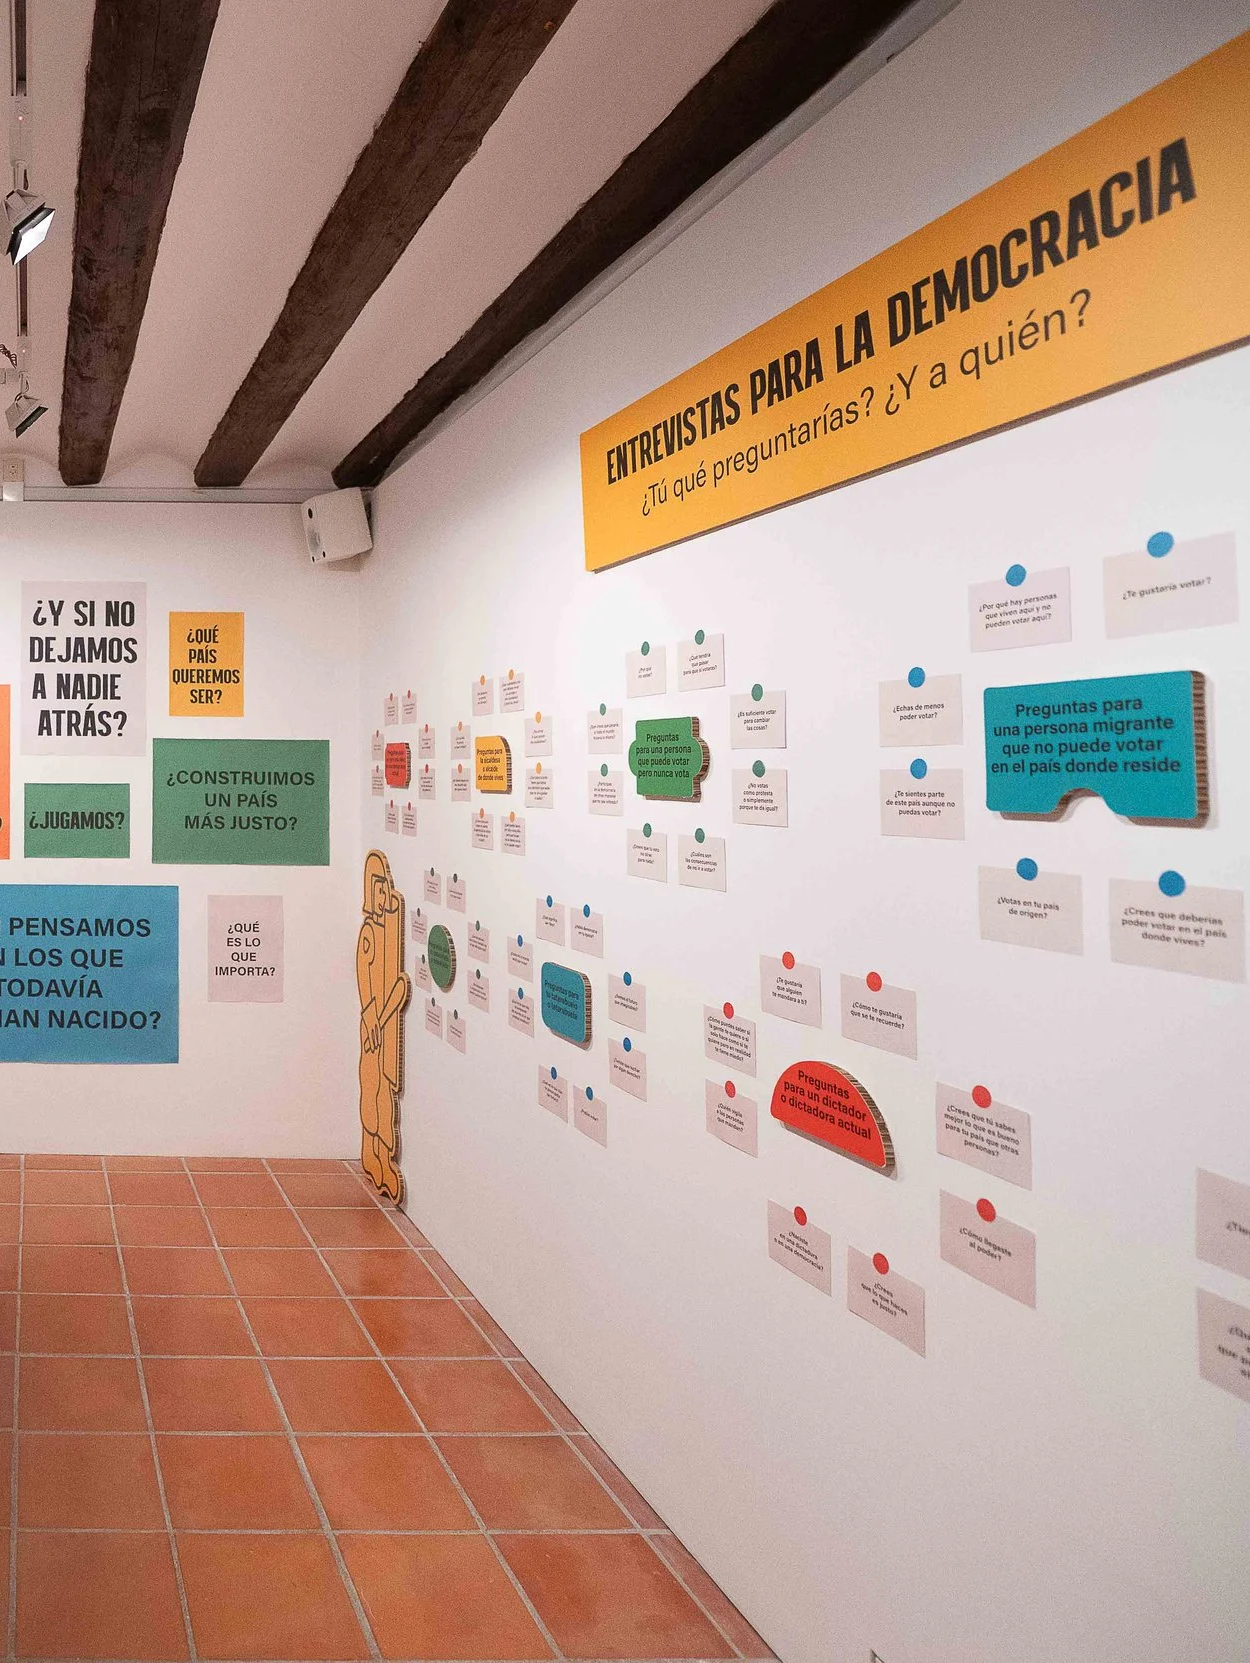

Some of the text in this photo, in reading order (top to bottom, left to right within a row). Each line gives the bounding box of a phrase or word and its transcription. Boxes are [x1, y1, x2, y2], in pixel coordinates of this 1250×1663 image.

[606, 136, 1197, 485] ENTREVISTAS PARA LA DEMOCRACIA
[642, 288, 1092, 516] ¿Tú qué preguntarías? ¿Y a quién?
[33, 600, 134, 626] ¿Y SI NO
[187, 625, 218, 644] ¿QUÉ
[30, 637, 137, 663] DEJAMOS
[189, 645, 216, 663] PAÍS
[173, 669, 240, 684] QUEREMOS
[32, 673, 121, 700] A NADIE
[190, 689, 222, 704] SER?
[1015, 698, 1143, 719] Preguntas para
[38, 703, 127, 736] ATRÁS?
[993, 715, 1174, 738] una persona migrante
[646, 733, 679, 744] Preguntas
[1002, 737, 1163, 757] que no puede votar
[636, 747, 649, 756] para
[664, 746, 691, 755] persona
[637, 758, 649, 767] que
[651, 757, 670, 767] puede
[991, 757, 1181, 775] en el país donde reside
[167, 770, 314, 786] ¿CONSTRUIMOS
[638, 770, 652, 778] pero
[674, 770, 689, 778] vota
[205, 790, 277, 808] UN PAÍS
[30, 812, 124, 829] ¿JUGAMOS?
[185, 812, 297, 830] MÁS JUSTO?
[10, 918, 150, 937] PENSAMOS
[228, 921, 259, 934] ¿QUÉ
[227, 938, 260, 947] ES LO
[15, 948, 62, 966] LOS
[71, 949, 123, 970] QUE
[231, 952, 256, 962] QUE
[216, 966, 275, 976] IMPORTA?
[49, 1010, 160, 1029] NACIDO?
[798, 1069, 850, 1099] Preguntas
[784, 1081, 867, 1121] para un dictador
[780, 1094, 871, 1140] o dictadora actual
